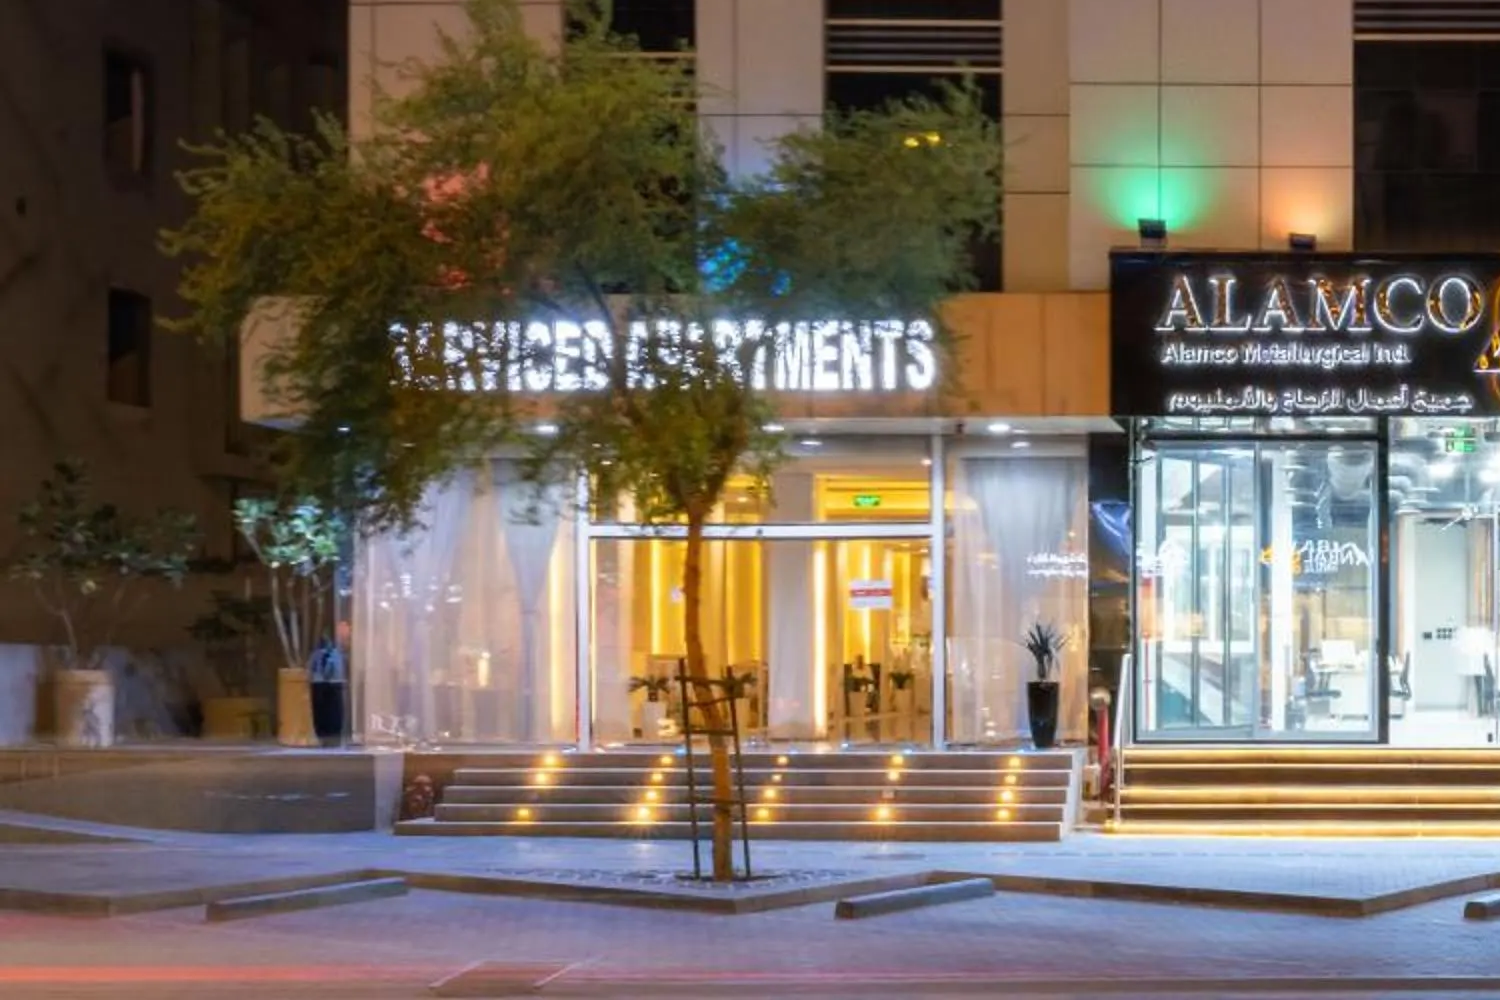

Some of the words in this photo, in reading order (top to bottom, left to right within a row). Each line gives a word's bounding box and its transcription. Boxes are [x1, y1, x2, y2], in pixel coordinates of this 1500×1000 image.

[1154, 275, 1483, 333] ALAMCO
[1160, 342, 1239, 364] Alamco
[1241, 341, 1371, 370] Metallurgical
